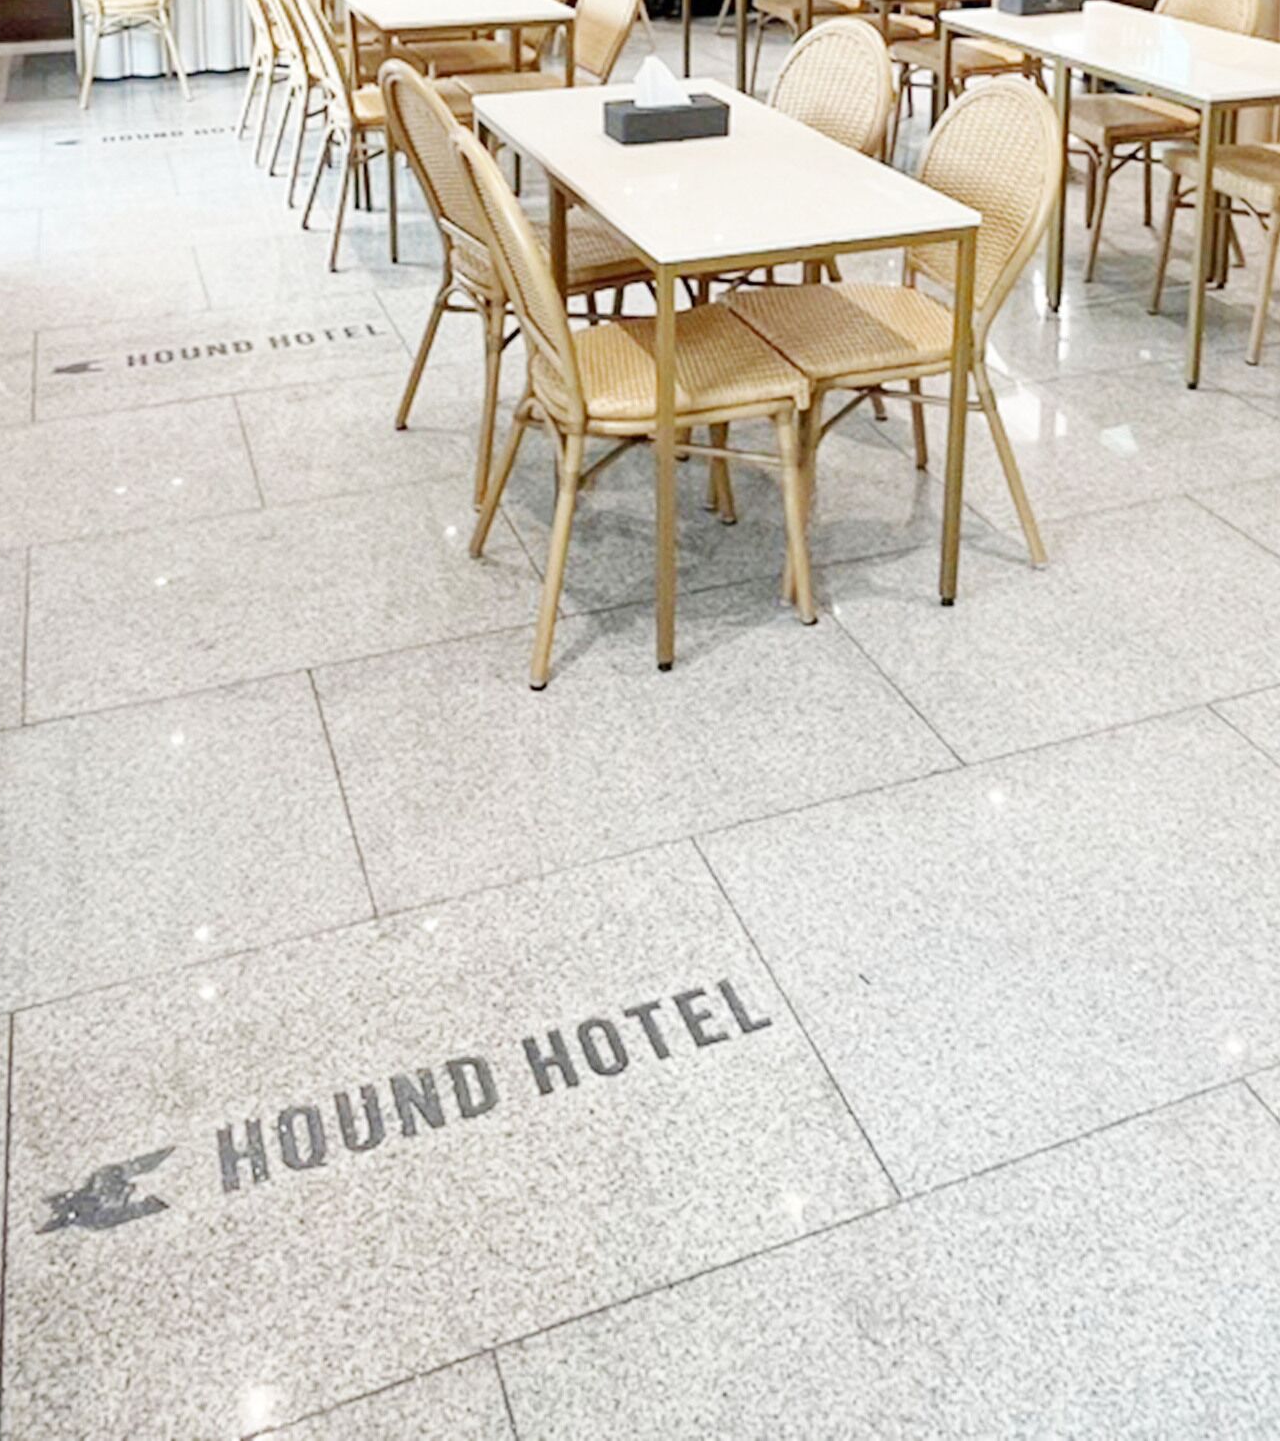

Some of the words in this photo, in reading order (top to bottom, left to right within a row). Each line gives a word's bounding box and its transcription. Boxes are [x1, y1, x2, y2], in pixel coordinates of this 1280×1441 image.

[126, 338, 255, 368] HOUND
[268, 322, 389, 351] HOTEL
[215, 1055, 500, 1194] HOUND
[521, 977, 774, 1097] HOTEL
